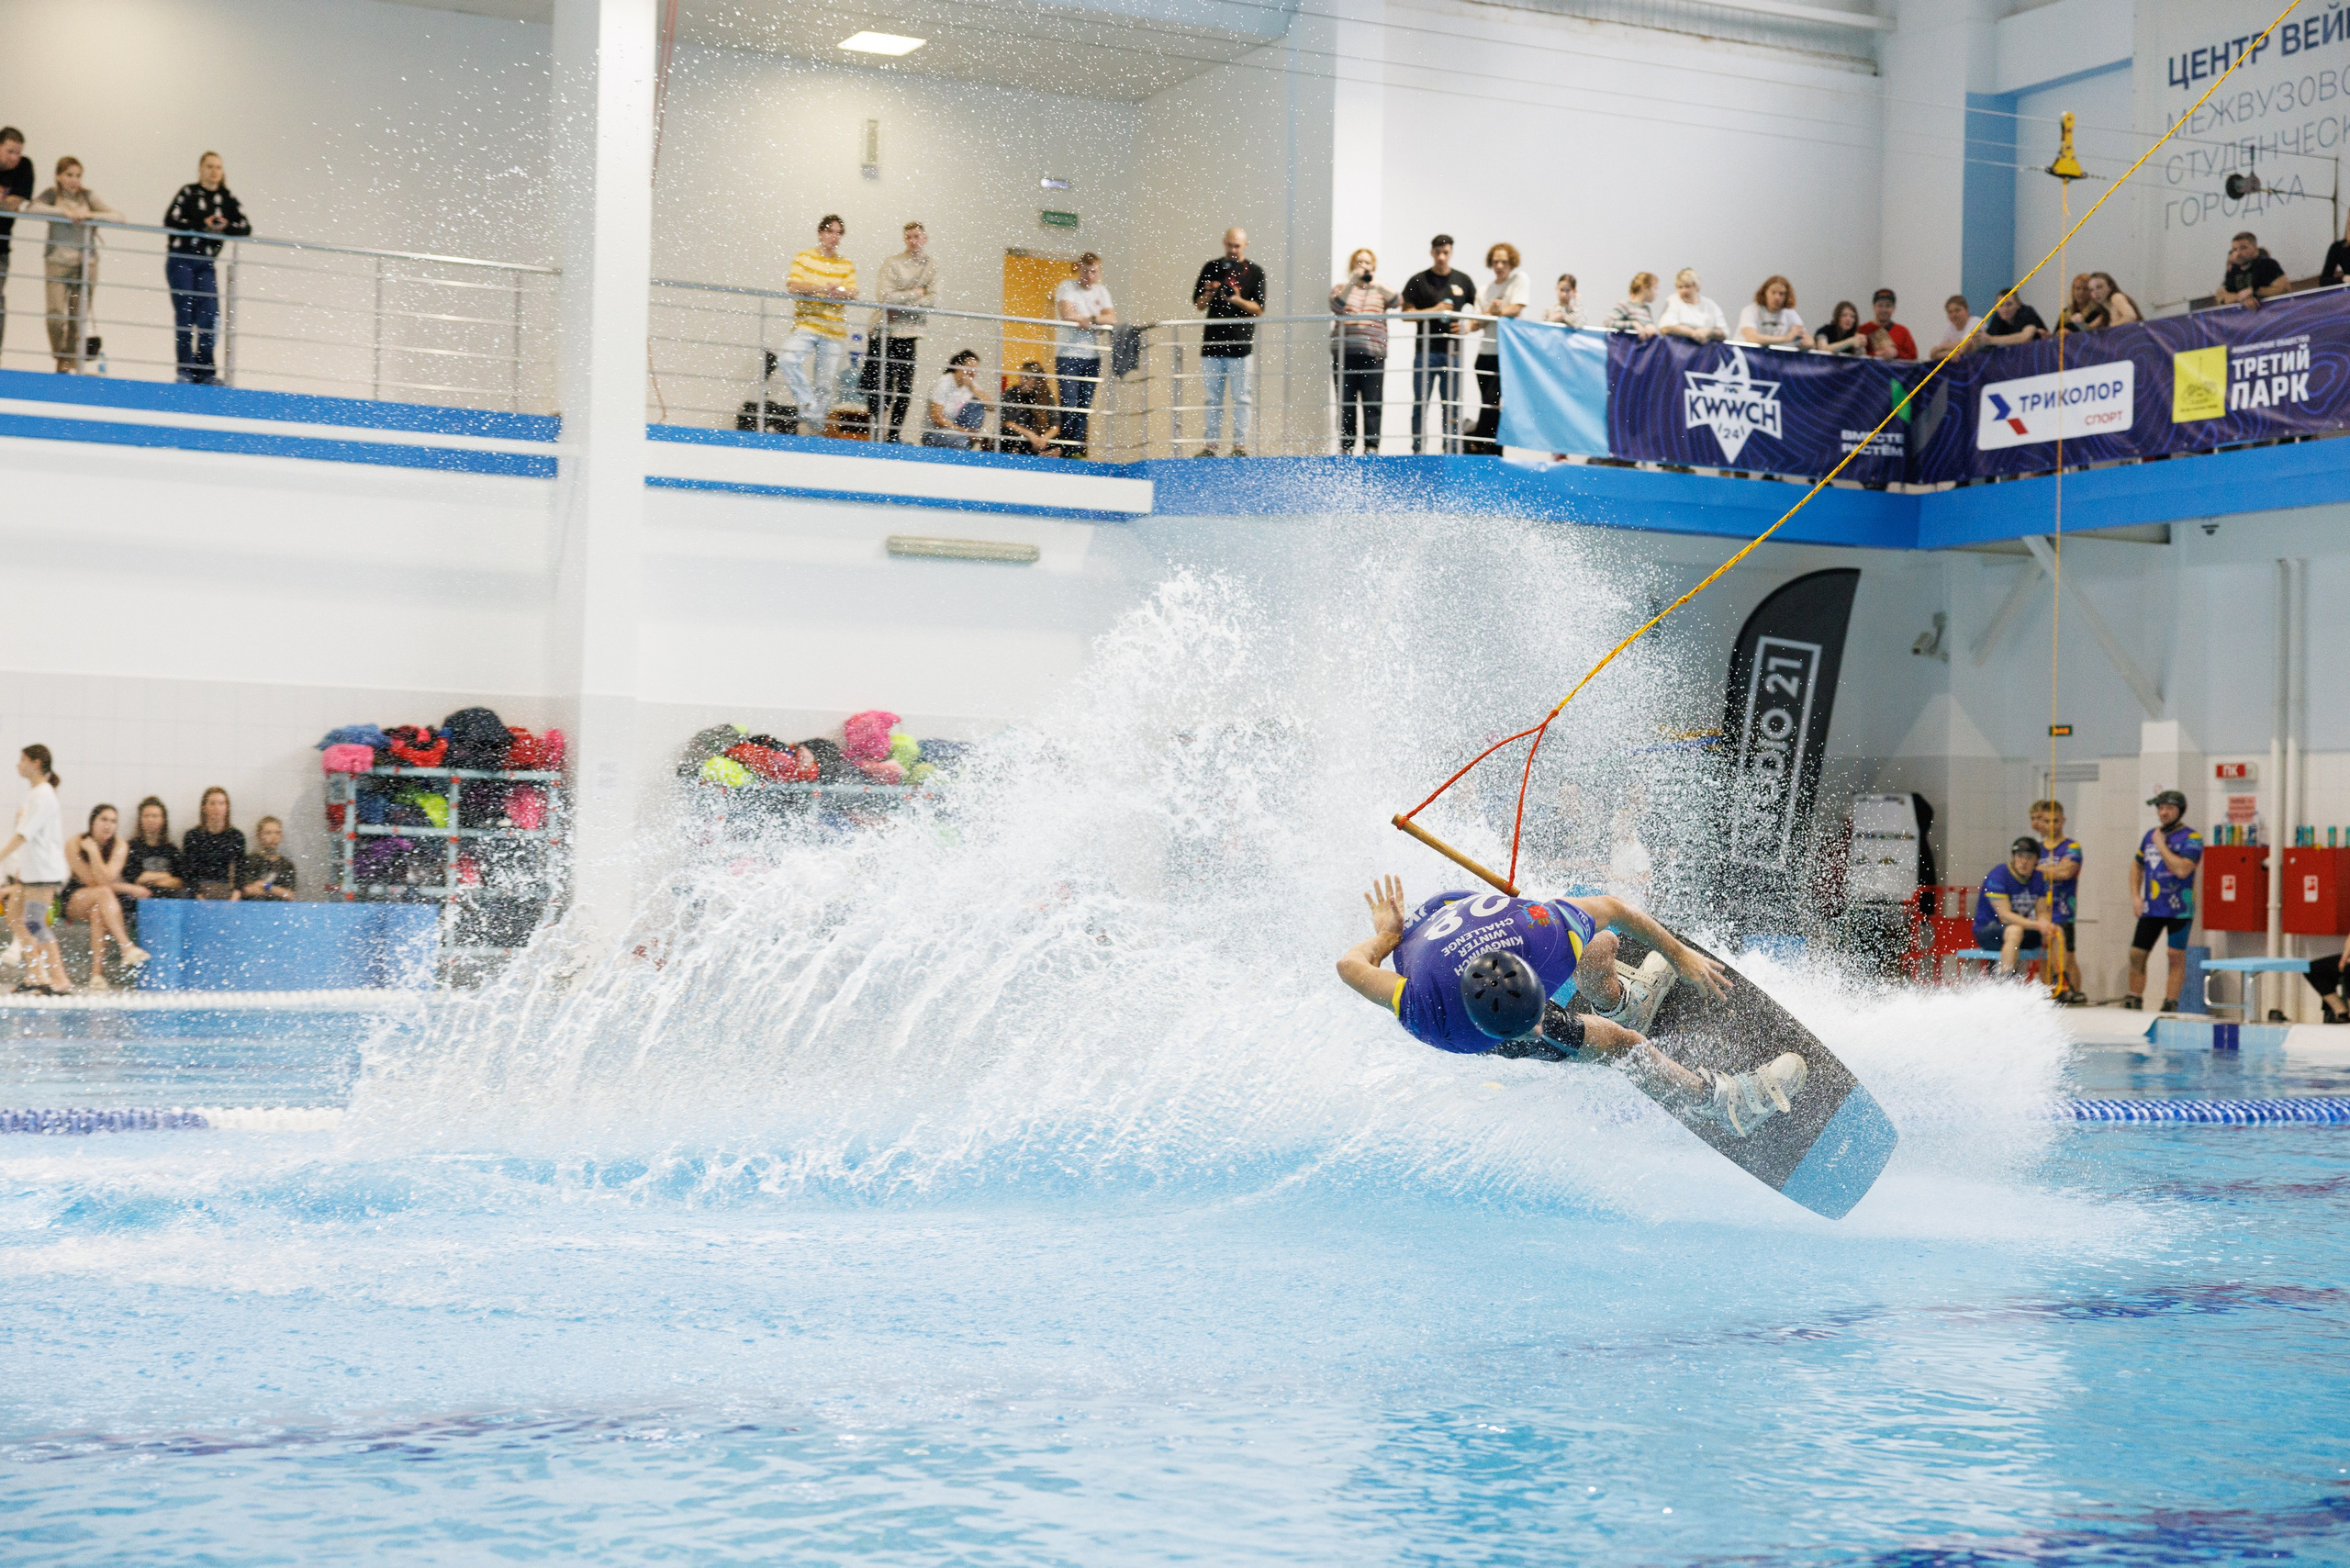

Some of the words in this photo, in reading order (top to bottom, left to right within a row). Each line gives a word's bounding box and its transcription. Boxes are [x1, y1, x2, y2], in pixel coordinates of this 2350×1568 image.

[2168, 31, 2270, 90] ЦЕНТР
[2281, 1, 2350, 57] ВЕЙ
[2232, 343, 2311, 380] ТРЕТИЙ
[2020, 381, 2123, 412] ТРИКОЛОР
[2231, 373, 2310, 410] ПАРК
[1689, 394, 1777, 431] KWWCH
[2085, 410, 2123, 426] СПОРТ
[1764, 656, 1803, 699] 21
[1441, 918, 1515, 957] CHALLENGE
[1458, 929, 1507, 958] WINTER
